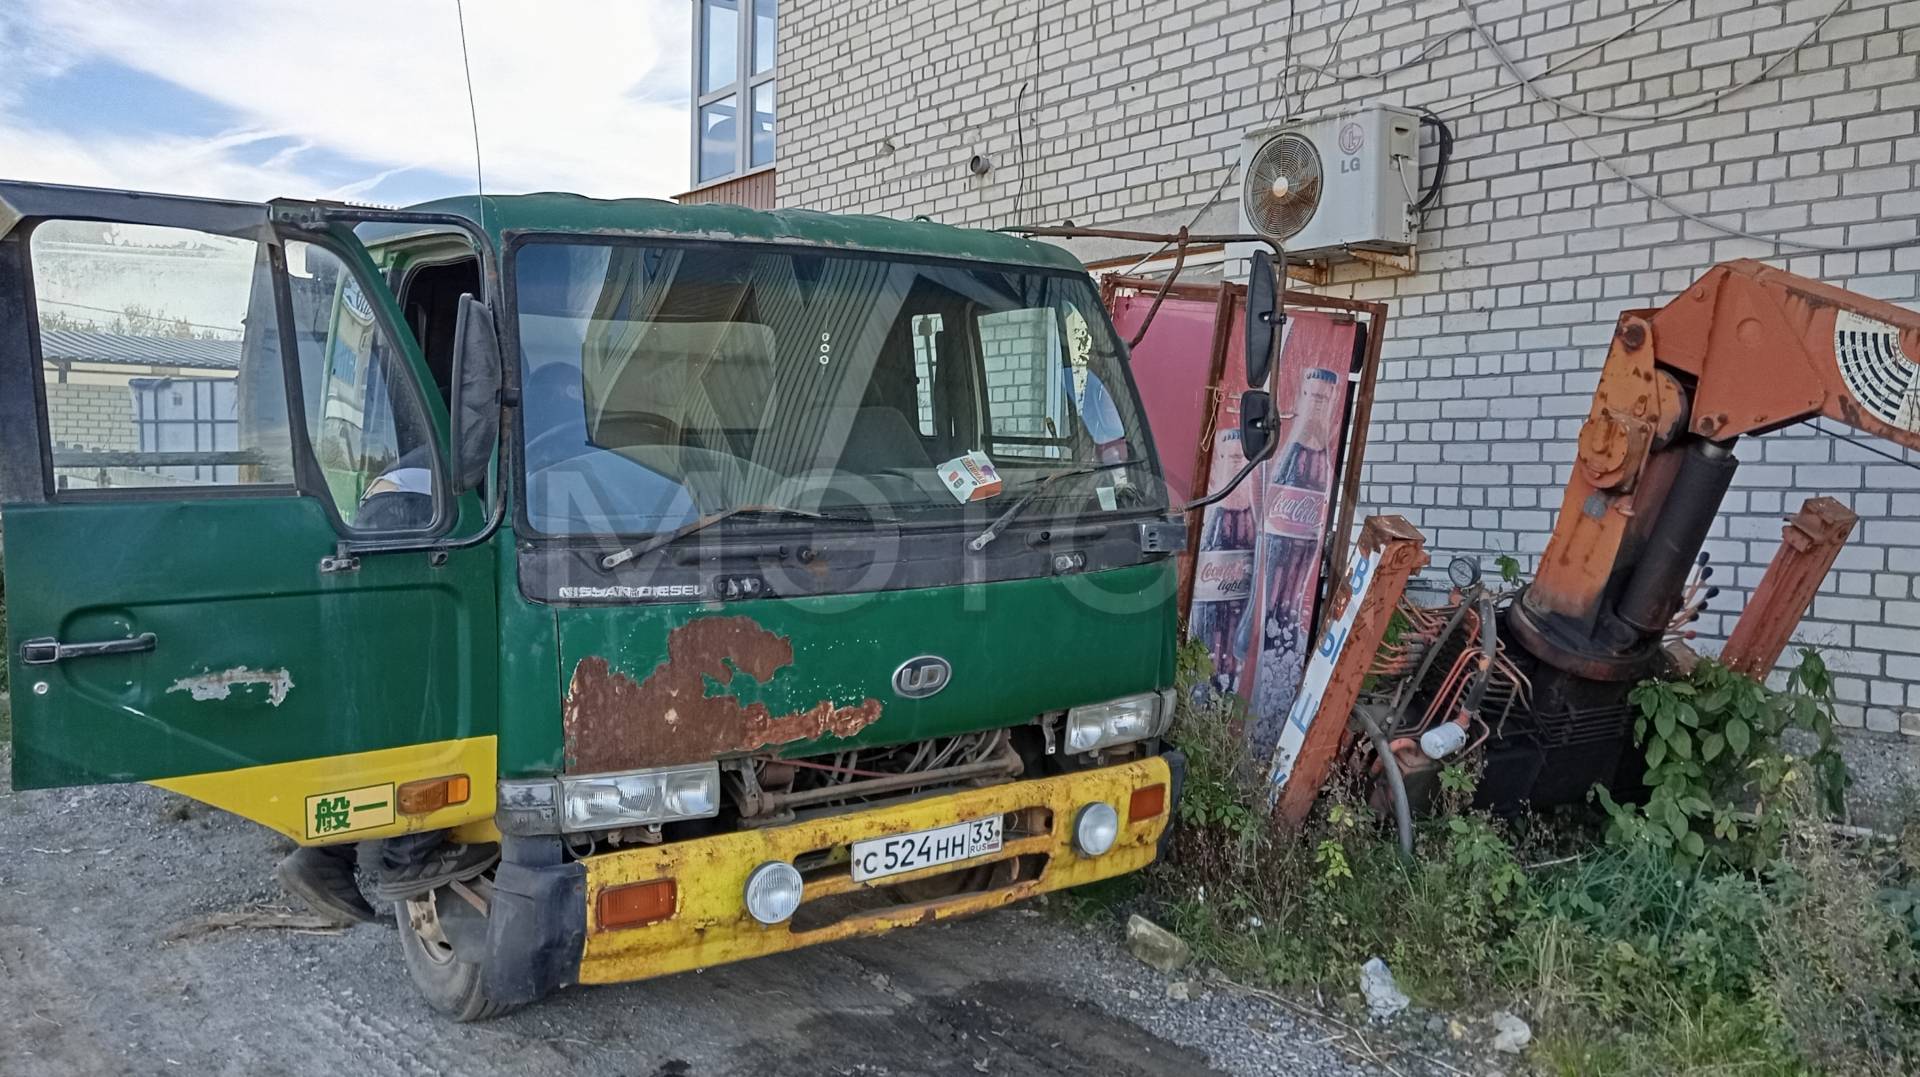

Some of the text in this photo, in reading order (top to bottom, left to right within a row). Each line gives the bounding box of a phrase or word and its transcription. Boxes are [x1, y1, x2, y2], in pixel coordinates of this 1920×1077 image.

[1341, 157, 1361, 174] LG
[559, 584, 706, 598] NISSAN DIESEL
[1217, 579, 1242, 595] light
[901, 664, 947, 691] UD
[972, 821, 994, 844] 33
[970, 844, 987, 854] RUS
